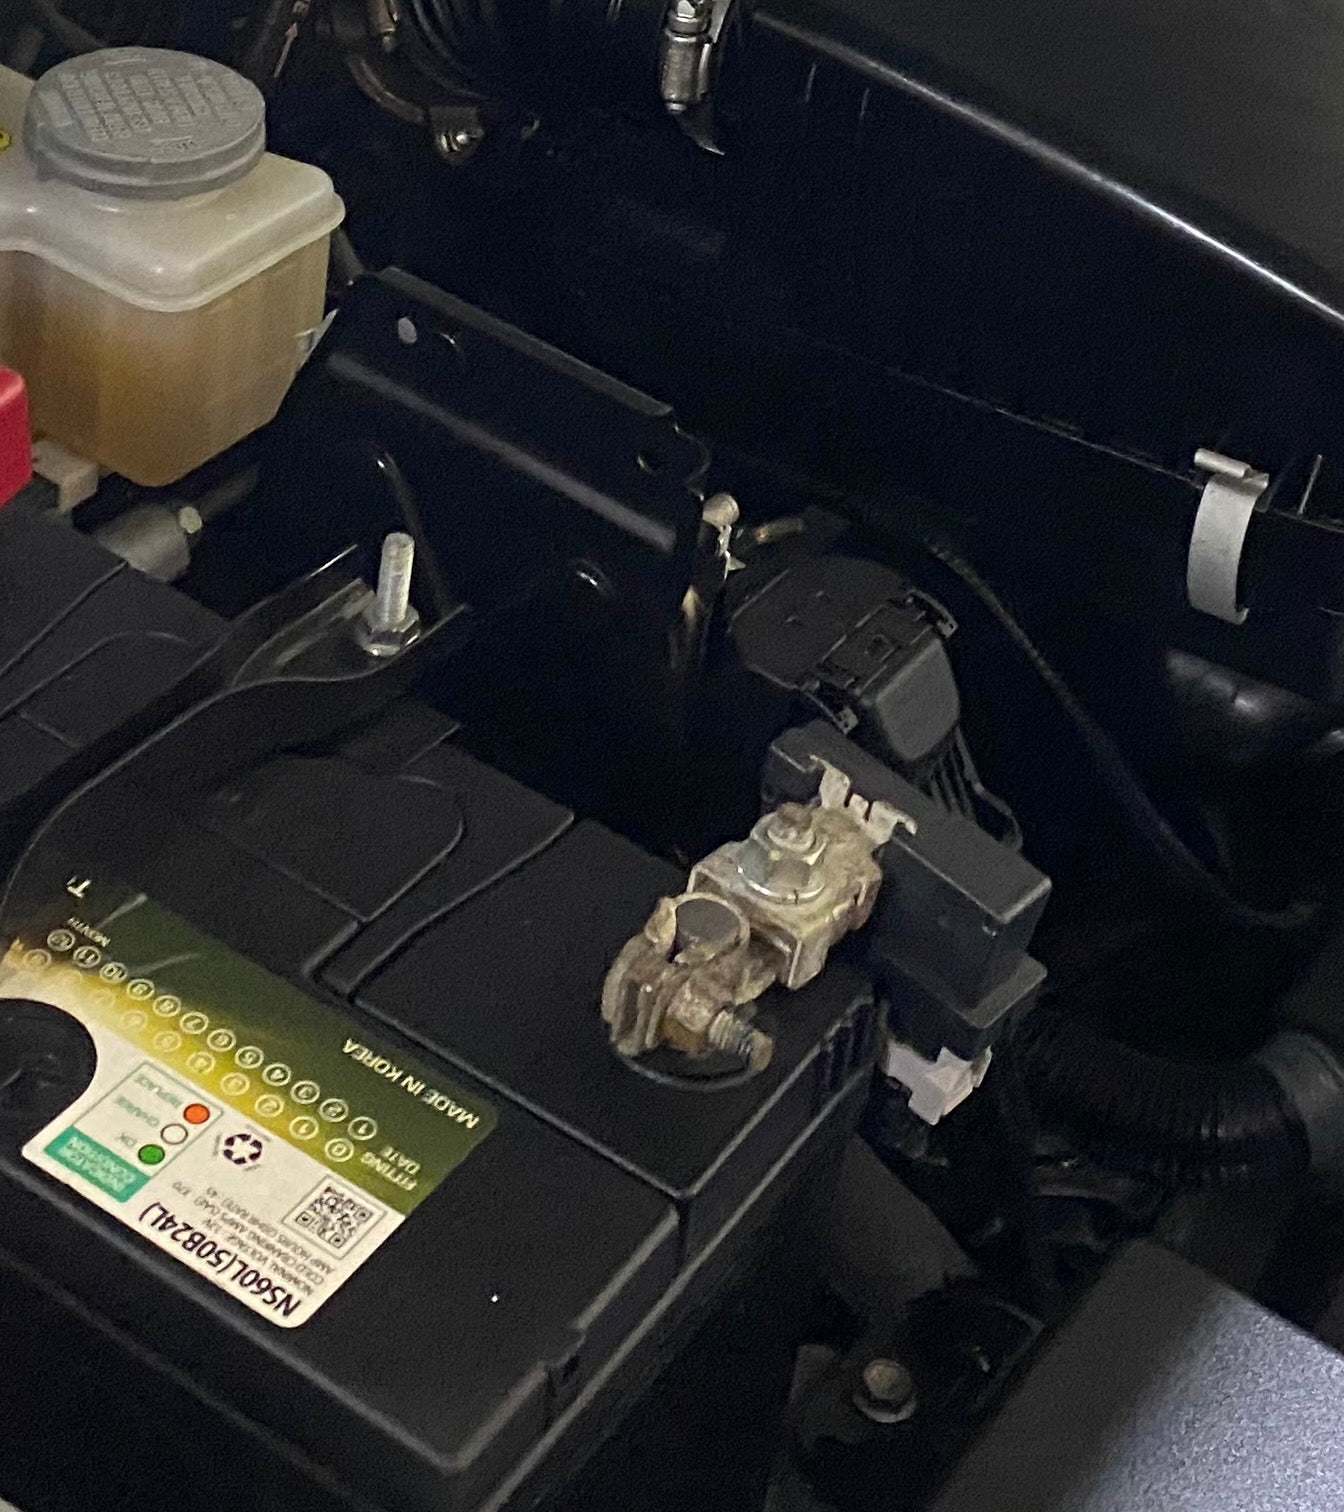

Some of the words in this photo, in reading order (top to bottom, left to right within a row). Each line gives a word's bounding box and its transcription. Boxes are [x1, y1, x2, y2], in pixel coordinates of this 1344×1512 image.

[341, 1036, 403, 1082] KOREA
[400, 1073, 426, 1095] IN
[421, 1087, 480, 1129] MADE
[137, 1201, 302, 1319] NS60L(50B24L)
